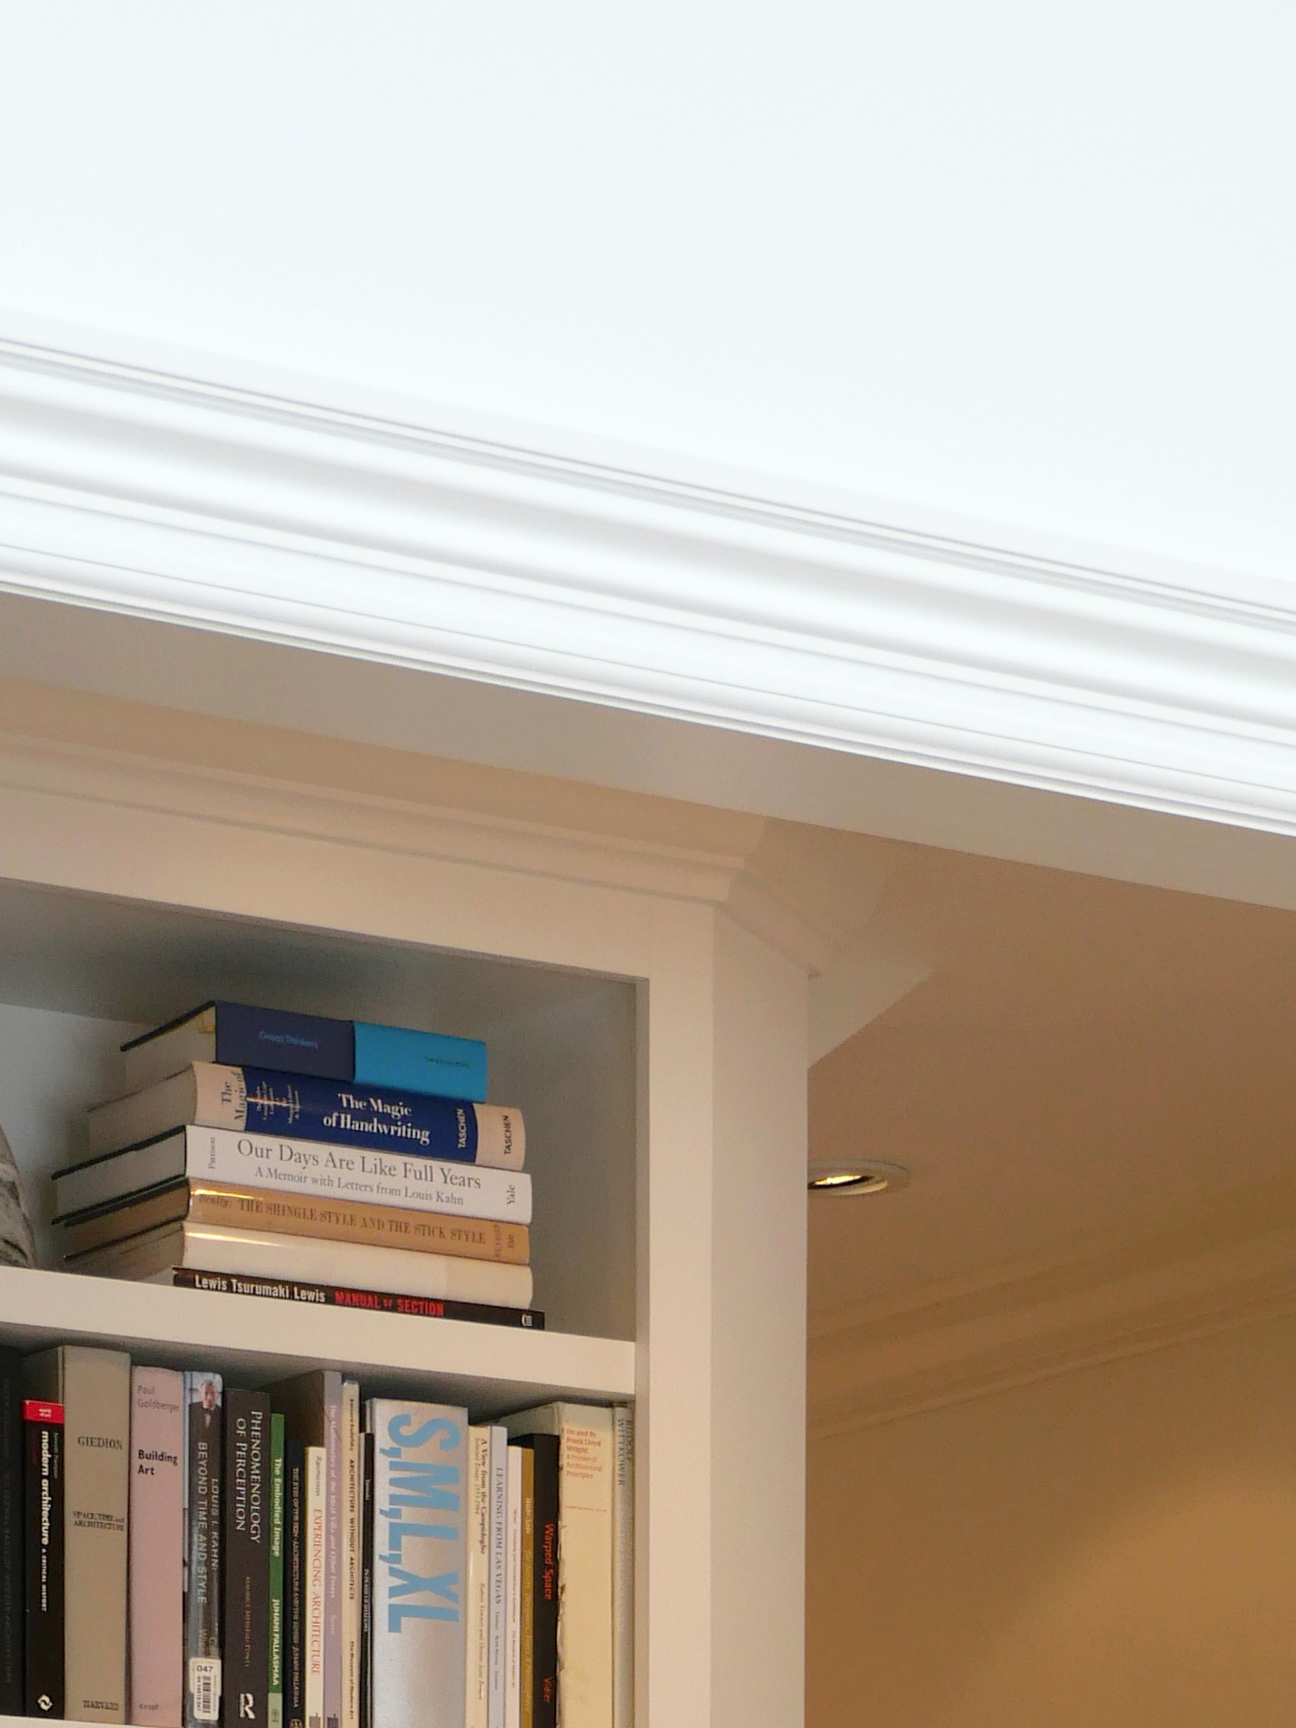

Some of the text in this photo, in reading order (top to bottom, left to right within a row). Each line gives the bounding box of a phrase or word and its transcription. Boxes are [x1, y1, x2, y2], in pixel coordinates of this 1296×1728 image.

[323, 1112, 430, 1144] of Handwriting
[338, 1093, 411, 1118] The Magic
[503, 1115, 511, 1155] TASCHEN
[237, 1138, 481, 1189] Our Days Are Like Full Years
[255, 1166, 463, 1205] A Memoir with Letters from Louis Kahn
[235, 1419, 248, 1531] OF PERCEPTION
[249, 1411, 263, 1543] PHENOMENOLOGY
[379, 1414, 460, 1633] S,M,L,XL
